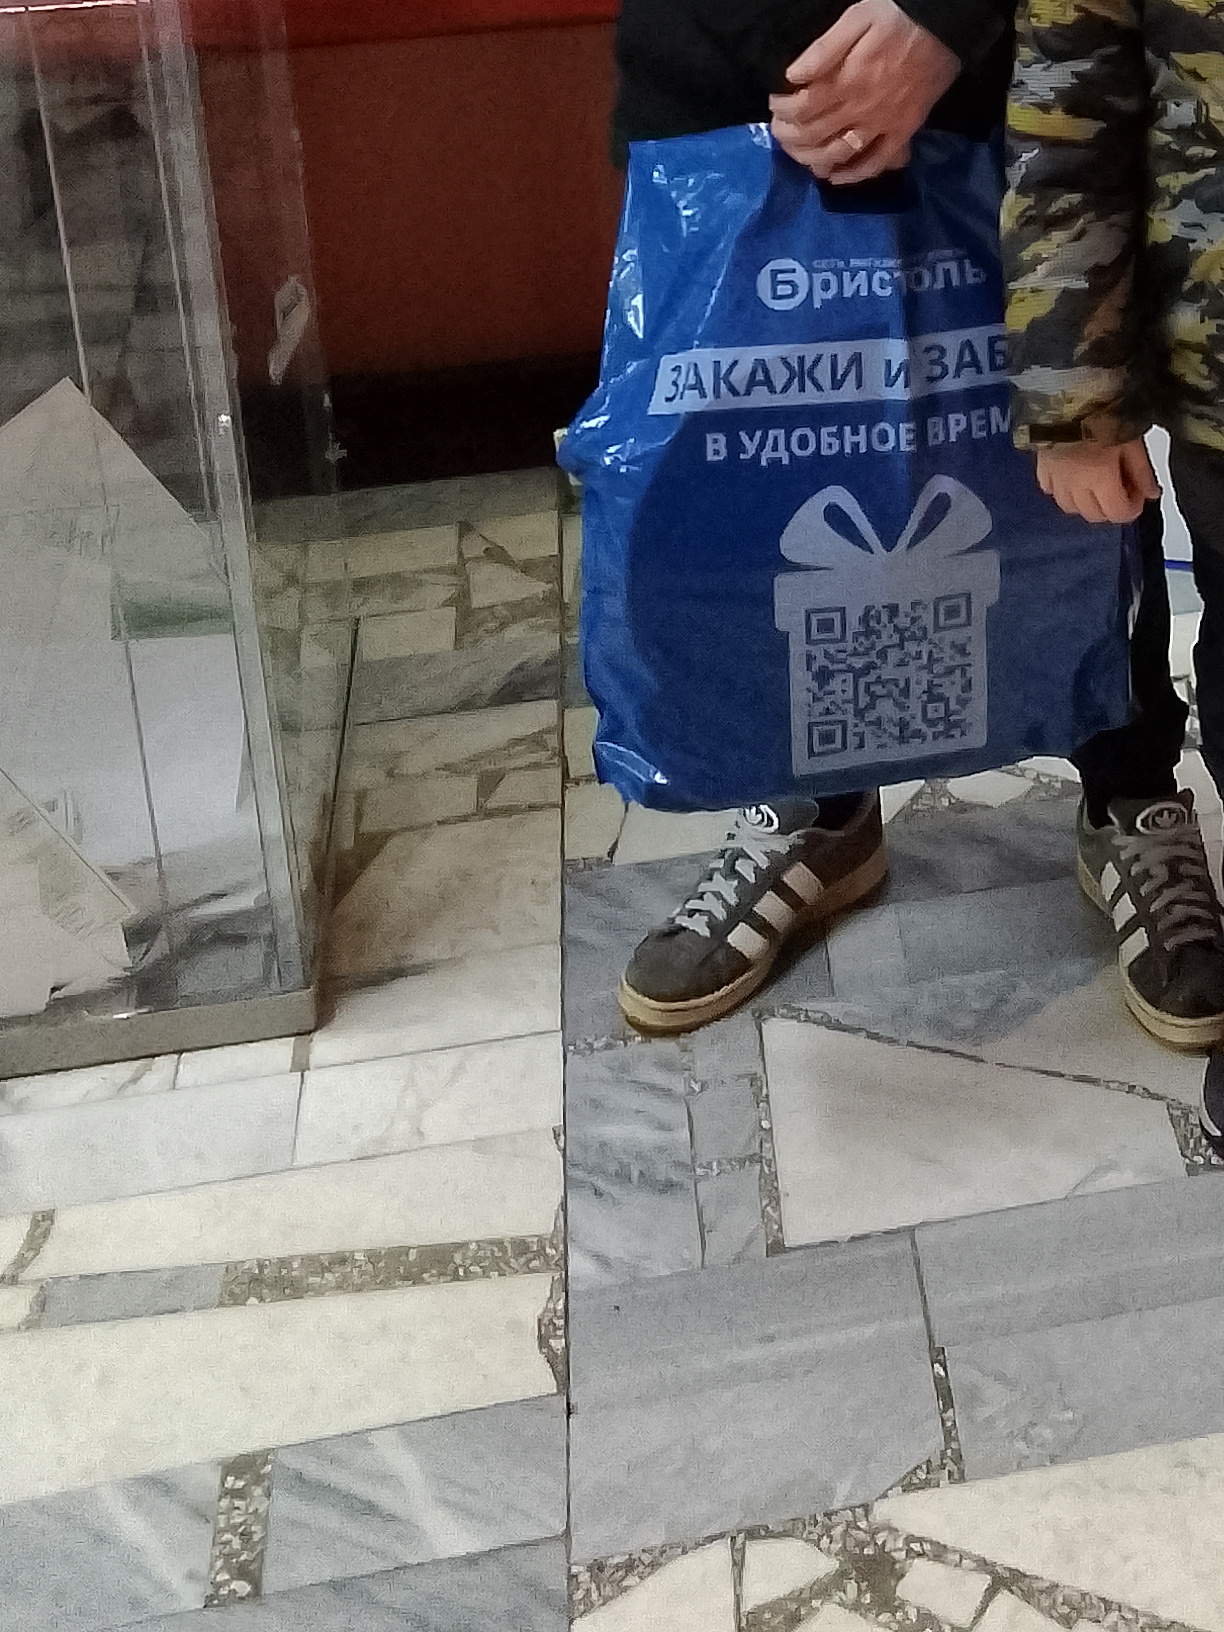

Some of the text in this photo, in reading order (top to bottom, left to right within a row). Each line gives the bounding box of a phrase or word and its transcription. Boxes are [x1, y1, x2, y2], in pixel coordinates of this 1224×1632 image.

[664, 352, 863, 403] ЗАКАЖИ
[706, 433, 728, 462] В
[738, 422, 917, 467] УДОБНОЕ
